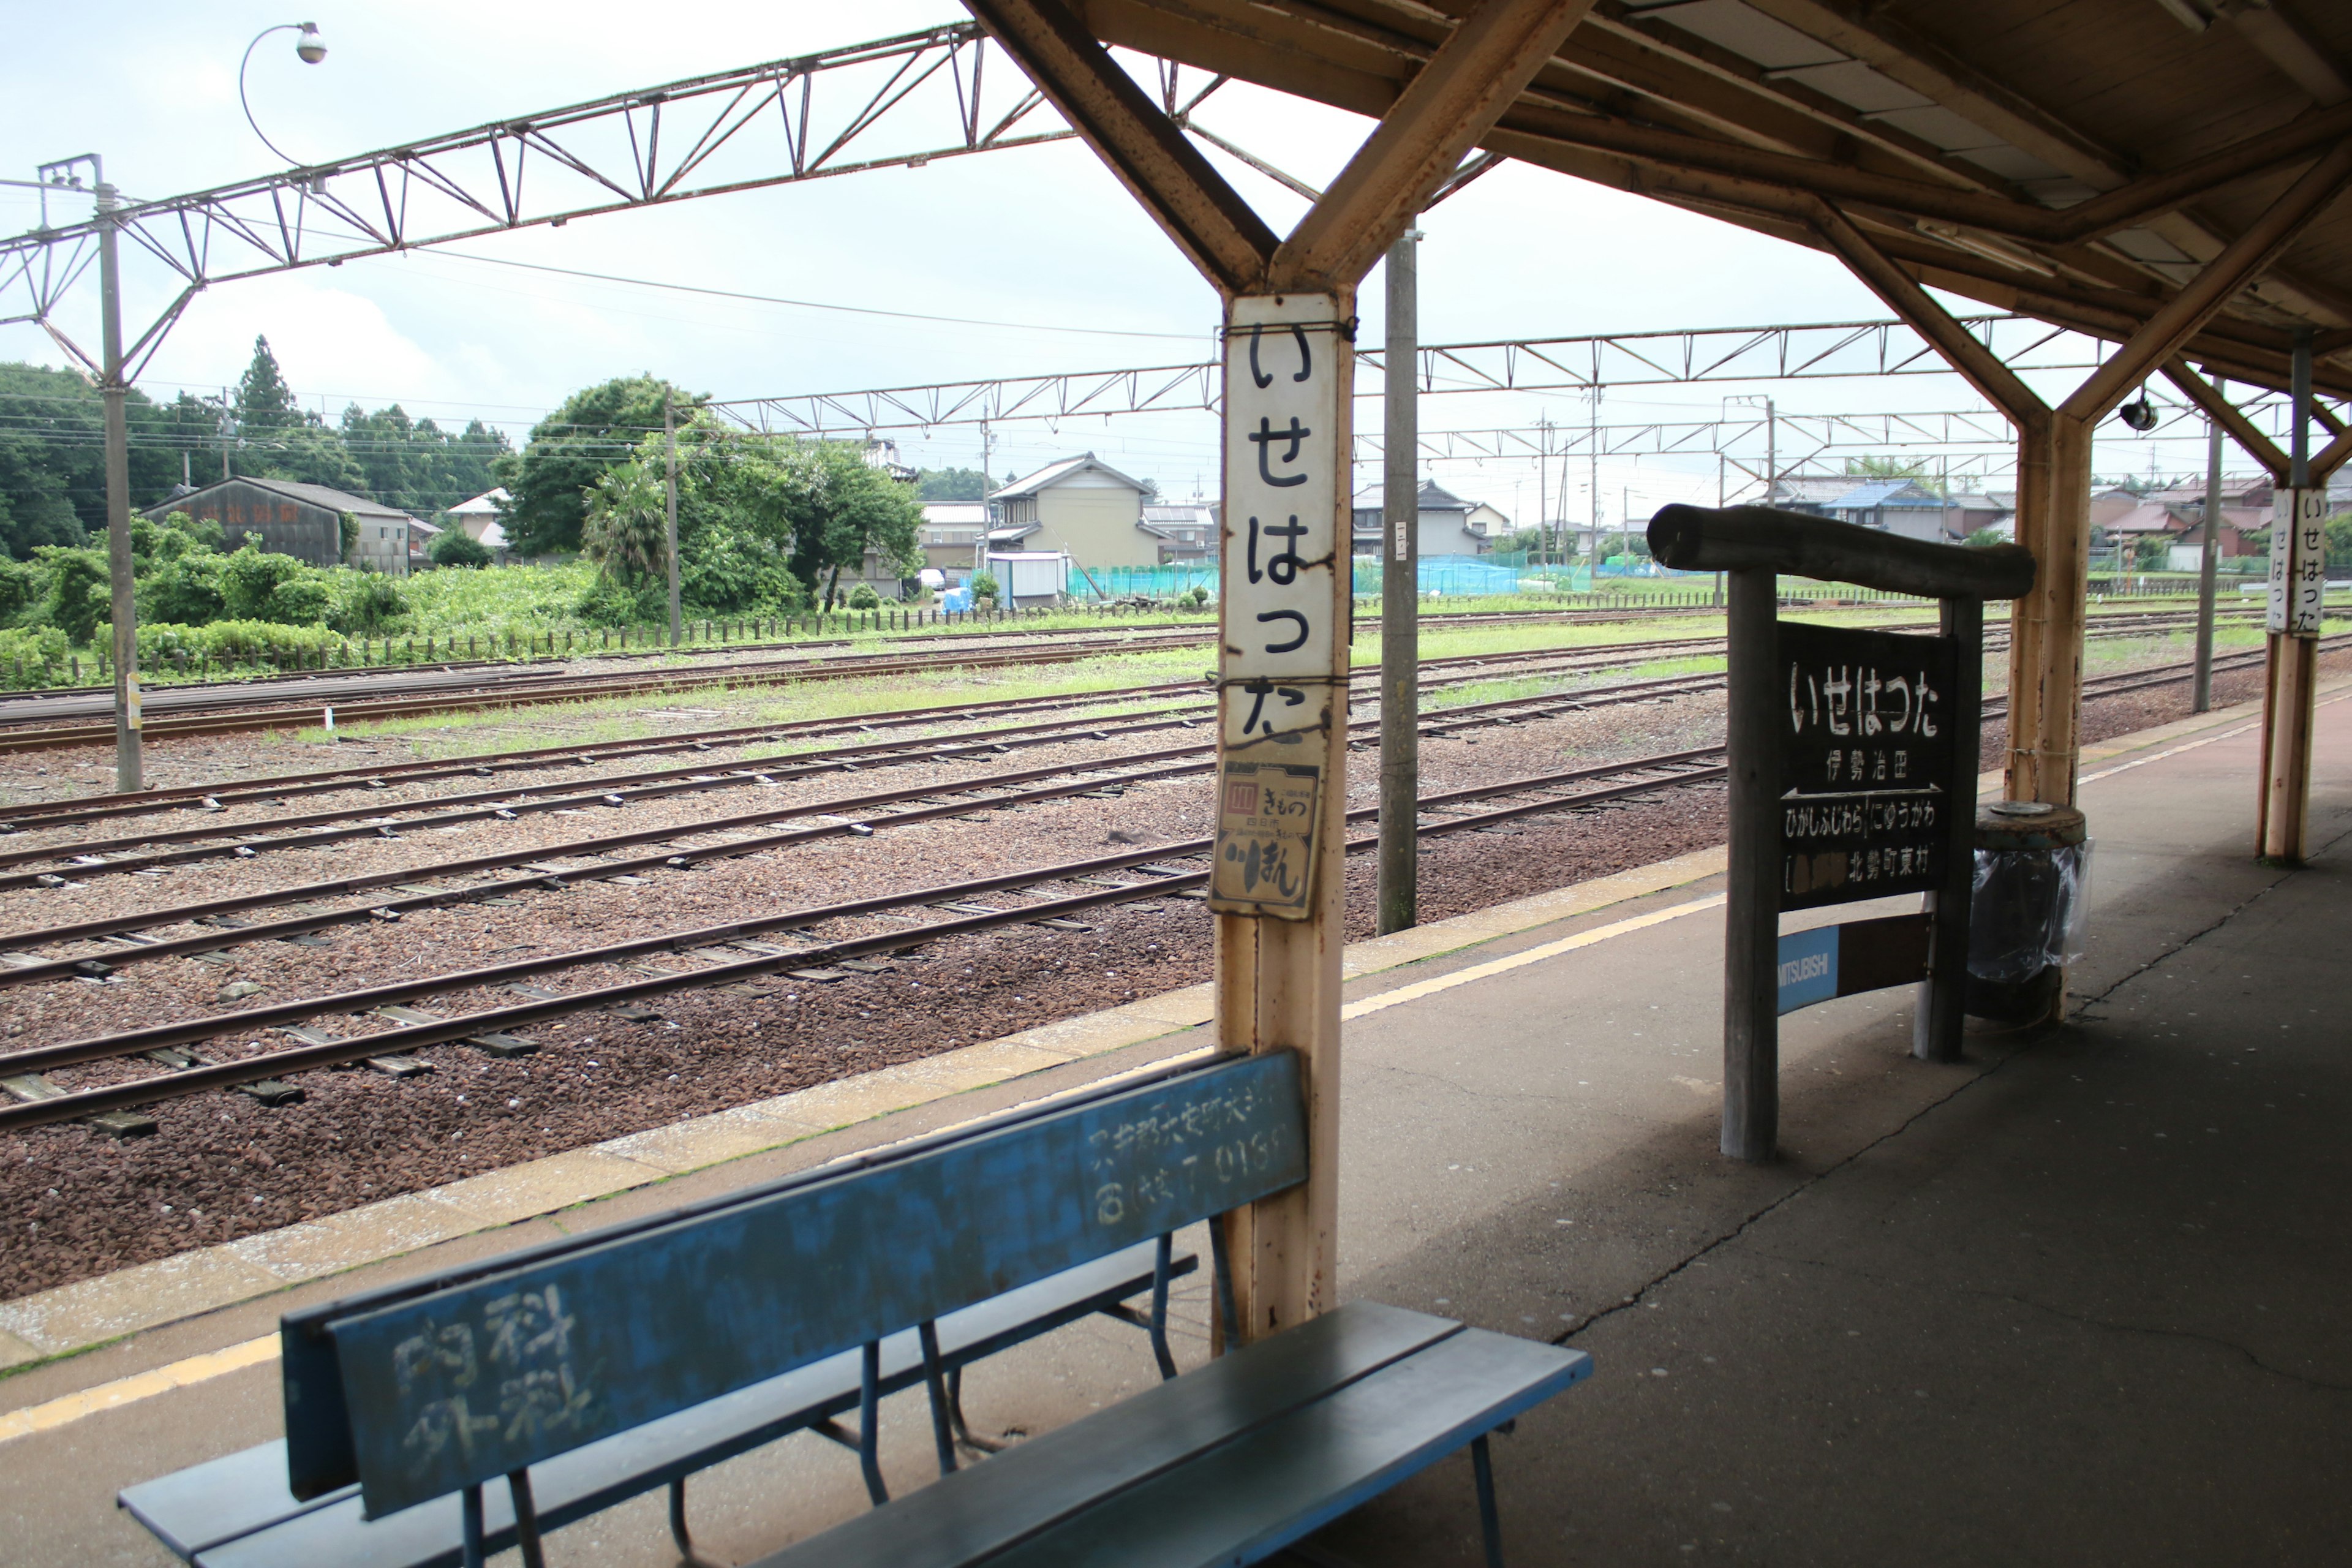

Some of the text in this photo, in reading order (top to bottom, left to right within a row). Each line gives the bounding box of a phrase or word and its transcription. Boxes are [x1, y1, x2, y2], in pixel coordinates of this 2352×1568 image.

[1243, 322, 1312, 745] いせはつた
[2271, 497, 2289, 629] いせはつた
[2298, 497, 2321, 630] いせはつた
[1790, 662, 1938, 736] いせはつた
[1826, 749, 1909, 782] 伊勢治田
[1264, 788, 1306, 816] きもの
[1785, 803, 1863, 839] ひがしふじわら
[1247, 817, 1280, 828] 四日市
[1849, 845, 1929, 883] 北勢町東村
[1777, 952, 1828, 987] MITSUBISHI
[394, 1283, 577, 1399] 内科
